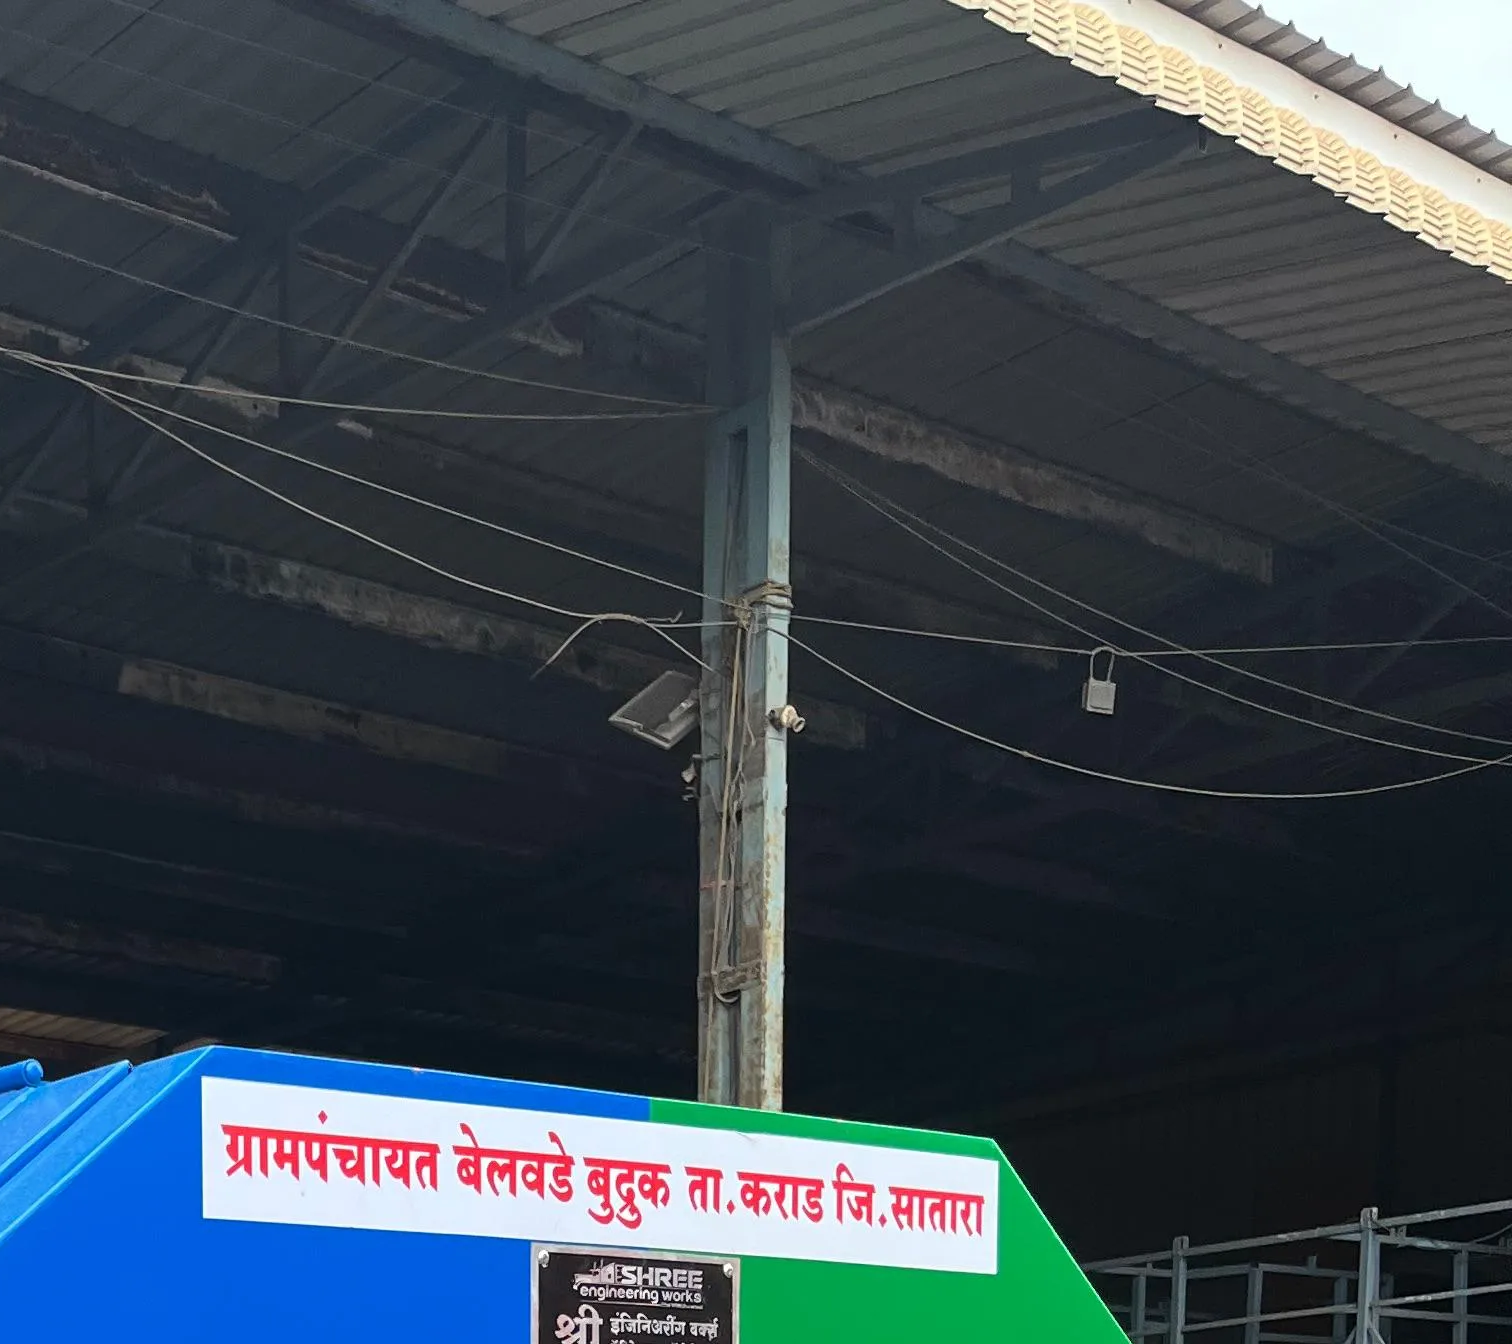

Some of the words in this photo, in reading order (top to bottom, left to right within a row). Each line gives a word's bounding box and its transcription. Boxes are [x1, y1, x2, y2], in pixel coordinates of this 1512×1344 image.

[221, 1110, 439, 1191] ग्रामपंचायत
[453, 1122, 574, 1203] बेलवडे
[620, 1264, 703, 1290] SHREE
[580, 1285, 659, 1304] engineering
[661, 1289, 702, 1303] works
